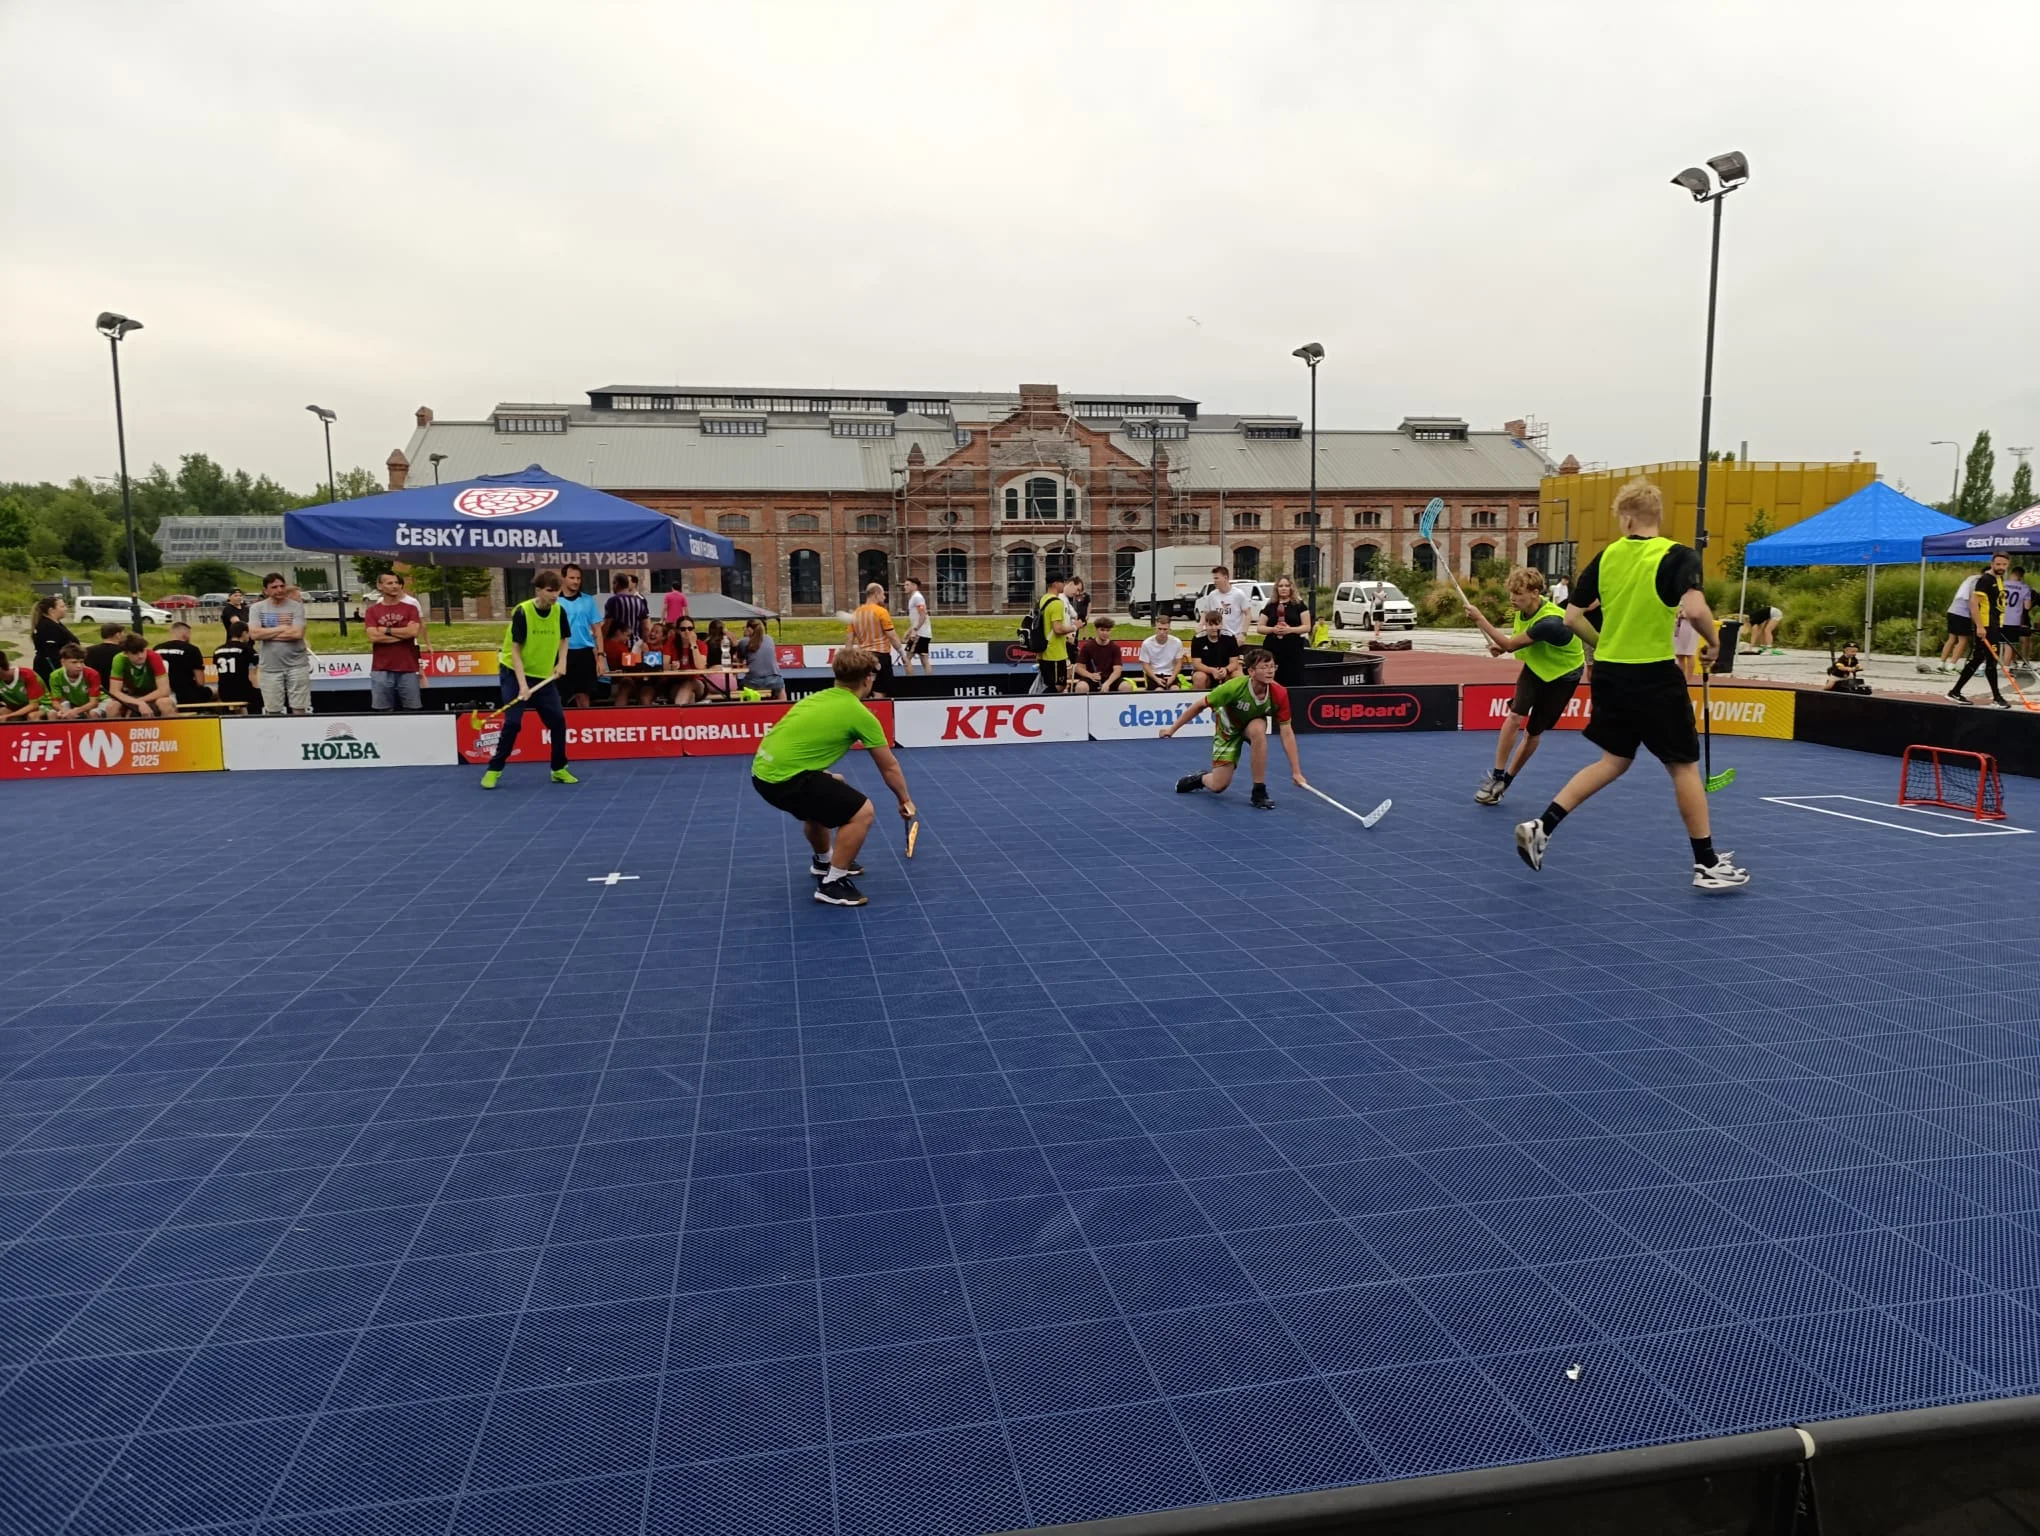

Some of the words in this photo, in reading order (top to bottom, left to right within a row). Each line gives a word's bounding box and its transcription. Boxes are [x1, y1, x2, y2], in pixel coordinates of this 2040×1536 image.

[396, 523, 465, 547] ČESKÝ
[470, 528, 563, 547] FLORBAL
[217, 657, 236, 674] 31
[941, 703, 1045, 740] KFC
[129, 727, 160, 741] BRNO
[541, 728, 578, 744] KC
[581, 726, 648, 744] STREET
[651, 723, 751, 741] FLOORBALL
[131, 740, 179, 754] OSTRAVA
[301, 742, 381, 761] HOLBA
[131, 755, 160, 767] 2025
